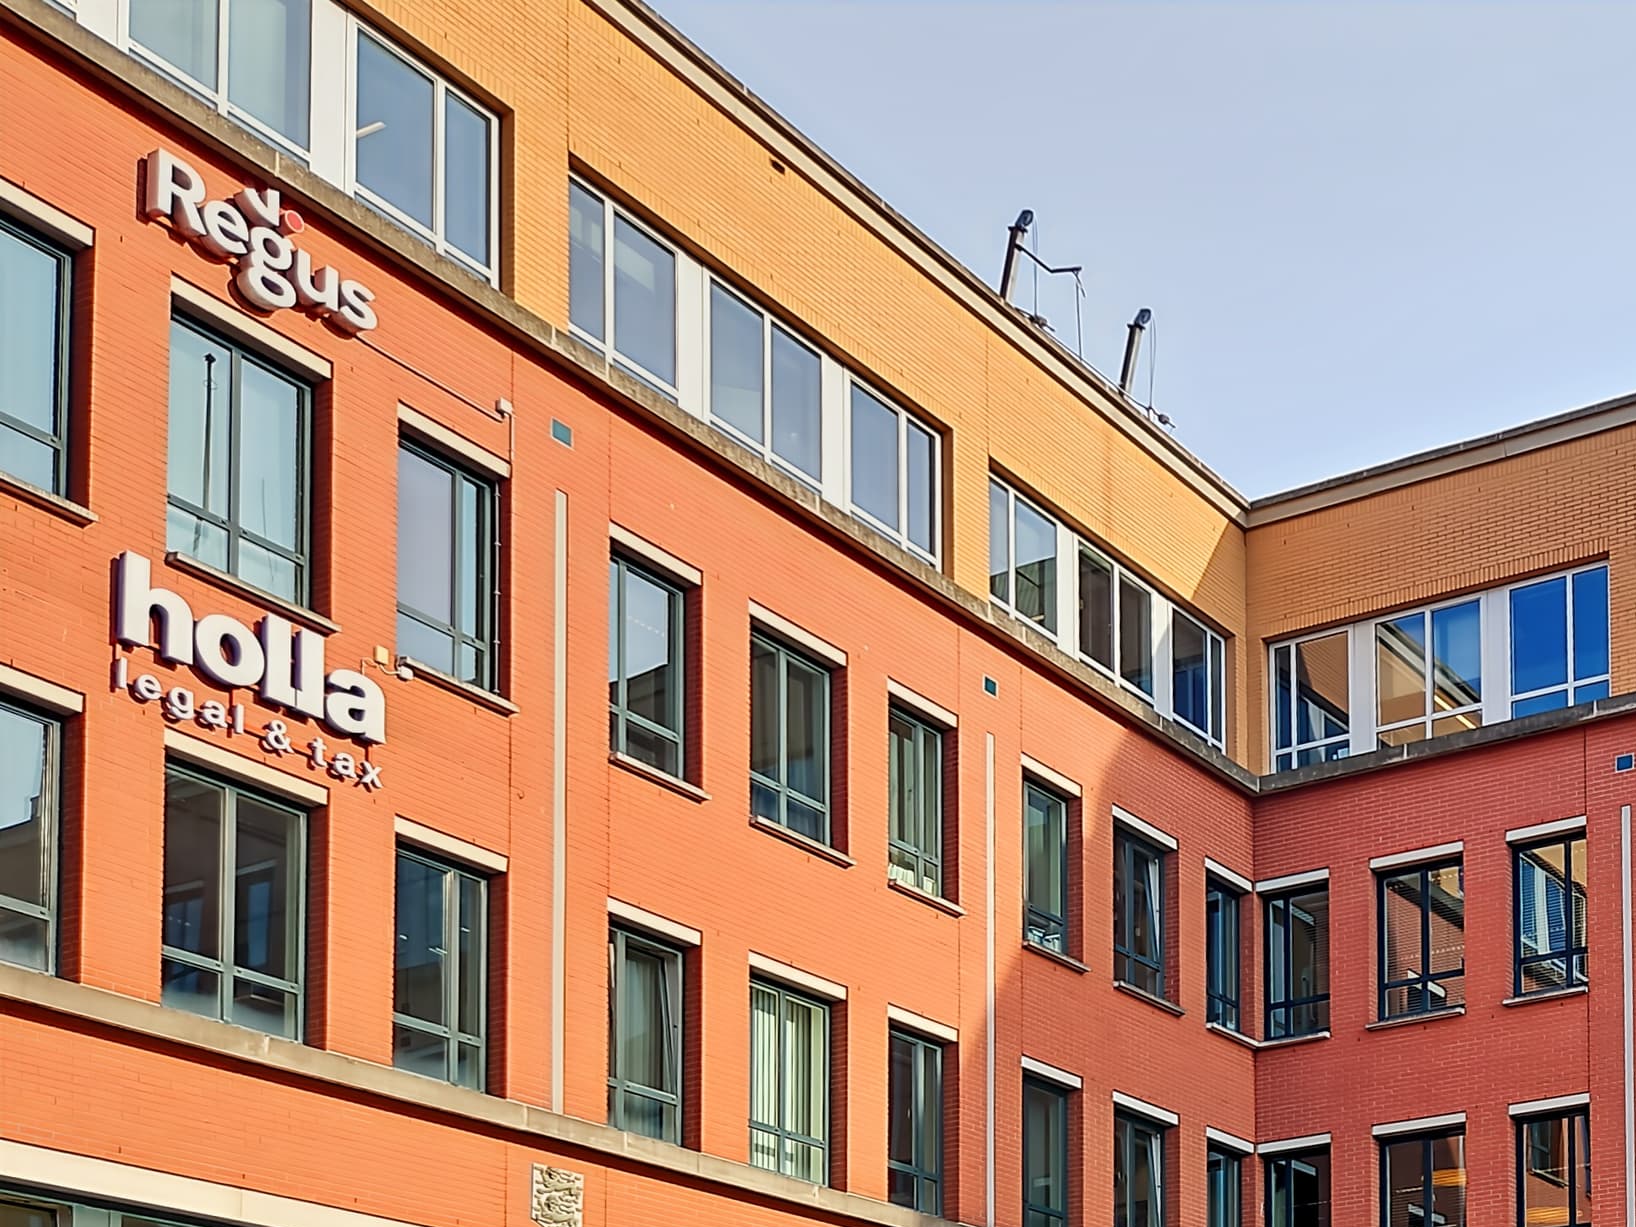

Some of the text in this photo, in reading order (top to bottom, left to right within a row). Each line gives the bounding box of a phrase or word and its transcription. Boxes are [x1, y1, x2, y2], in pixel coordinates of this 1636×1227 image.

[146, 147, 378, 330] Regus
[114, 656, 383, 789] legal & tax
[116, 550, 387, 744] holla
